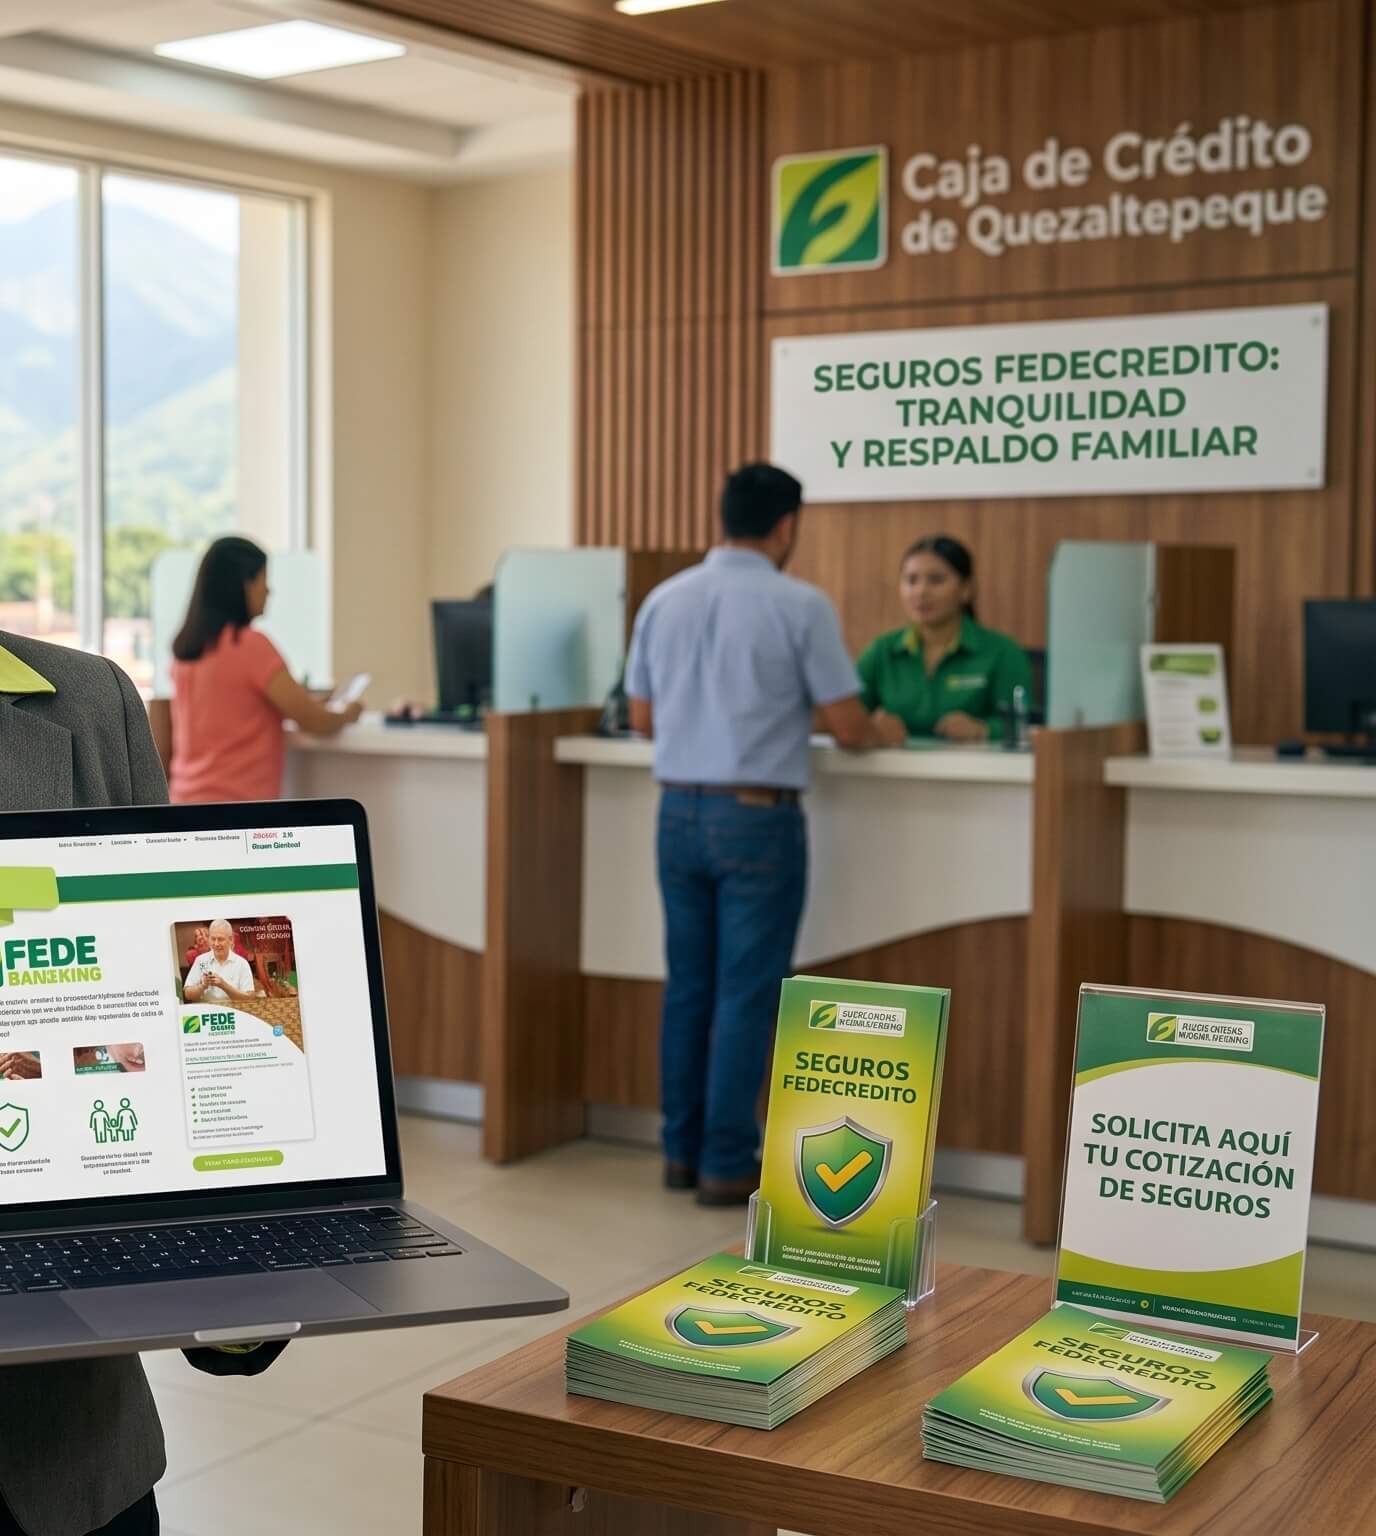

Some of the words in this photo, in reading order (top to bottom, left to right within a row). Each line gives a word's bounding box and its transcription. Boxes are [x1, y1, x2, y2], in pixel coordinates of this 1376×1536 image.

[902, 145, 1010, 206] Caja
[1024, 139, 1090, 189] de
[1105, 115, 1311, 181] Crédito
[902, 212, 957, 254] de
[968, 184, 1328, 255] Quezaltepeque
[813, 356, 983, 393] SEGUROS
[994, 340, 1281, 385] FEDECREDITO:
[896, 387, 1186, 429] TRANQUILIDAD
[831, 440, 852, 469] Y
[863, 432, 1059, 468] RESPALDO
[1071, 425, 1259, 461] FAMILIAR
[4, 935, 98, 970] FEDE
[201, 1012, 236, 1027] FEDE
[795, 1051, 910, 1081] SEGUROS
[783, 1074, 917, 1104] FEDECREDITO
[1091, 1112, 1211, 1148] SOLICITA
[1218, 1128, 1292, 1157] AQUÍ
[1083, 1143, 1118, 1167] TU
[1125, 1148, 1295, 1190] COTIZACIÓN
[1099, 1176, 1135, 1201] DE
[1140, 1182, 1271, 1219] SEGUROS
[683, 1281, 847, 1321] FEDECREDITO
[707, 1278, 846, 1311] SEGUROS
[1033, 1340, 1217, 1392] FEDECREDITO
[1057, 1336, 1212, 1380] SEGUROS
